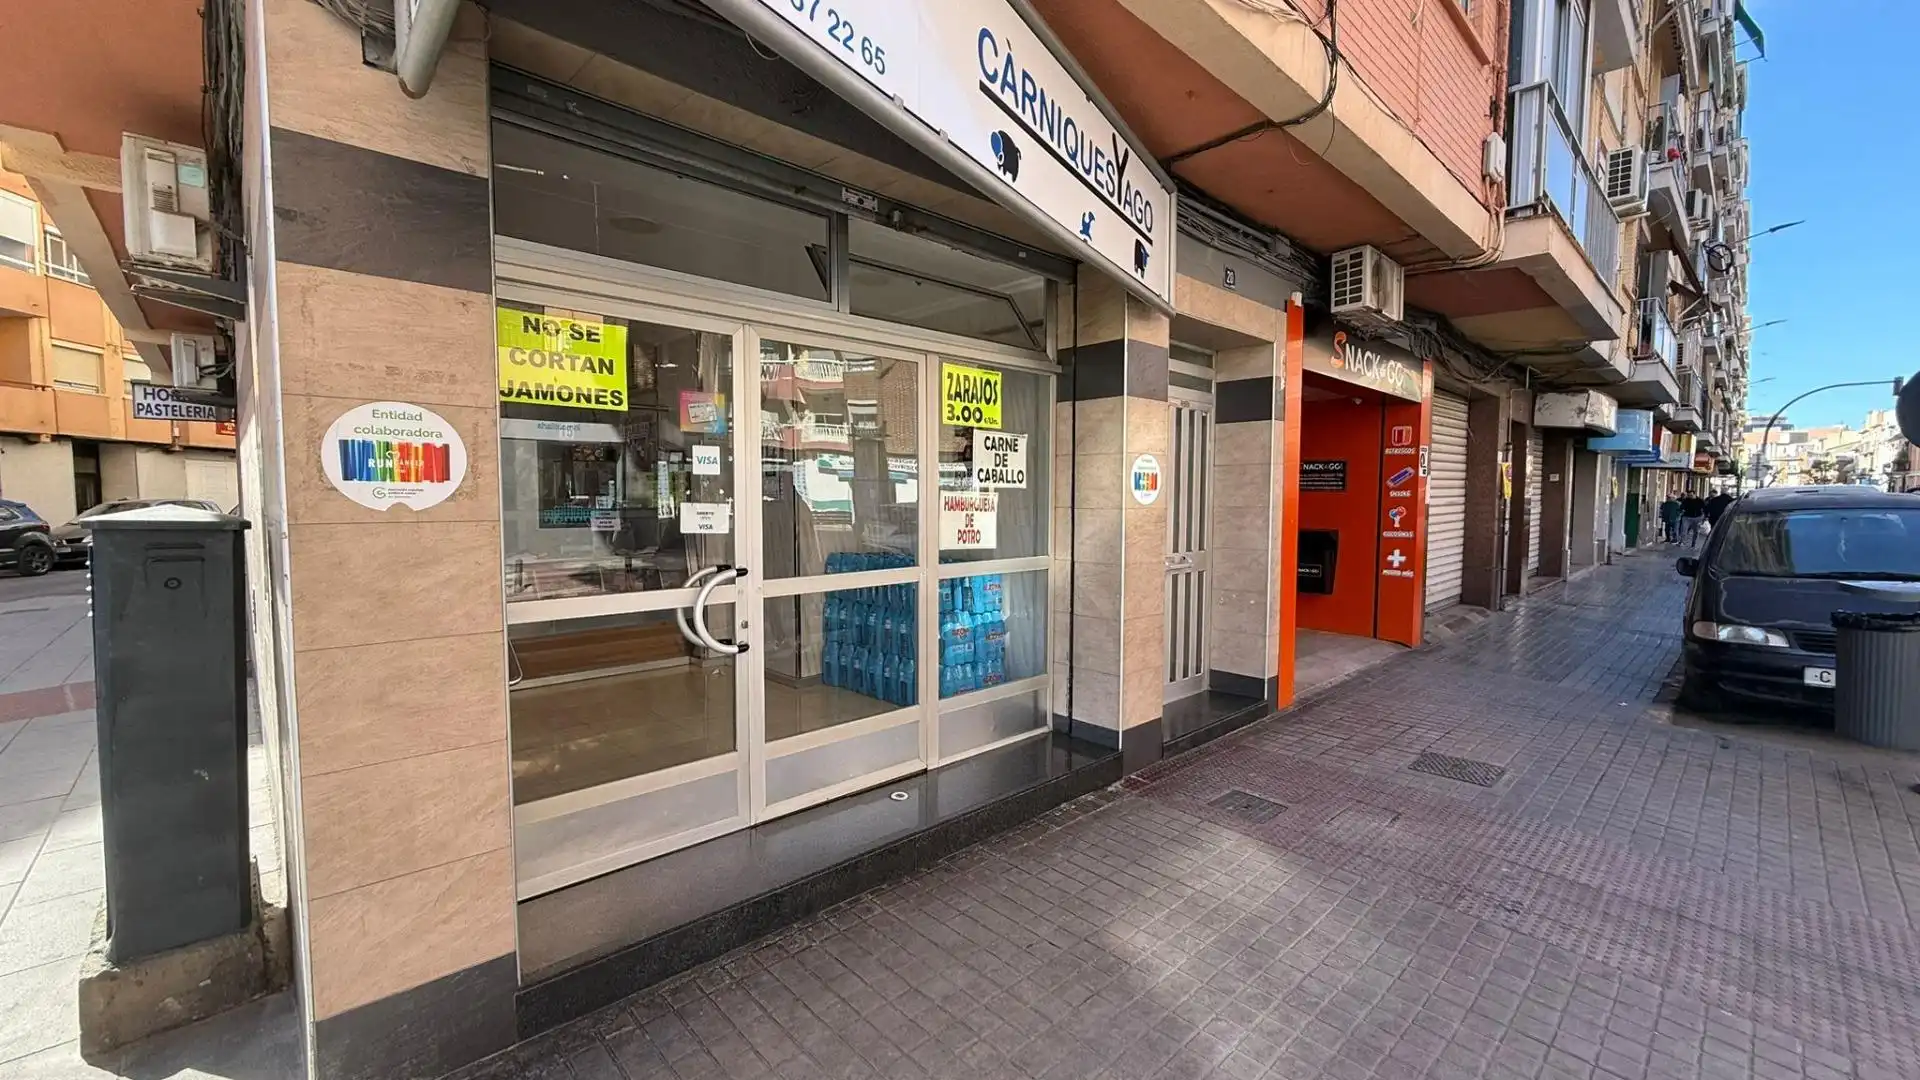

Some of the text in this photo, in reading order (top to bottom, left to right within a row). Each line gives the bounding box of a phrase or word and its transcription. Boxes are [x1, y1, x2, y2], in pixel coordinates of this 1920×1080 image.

[827, 8, 854, 53] 22
[861, 36, 885, 75] 65
[522, 315, 601, 343] NO SE
[508, 347, 614, 375] CORTAN
[499, 380, 624, 406] JAMONES
[946, 372, 998, 406] ZARAJOS
[372, 408, 423, 422] Entidad
[946, 403, 983, 424] 3.00
[353, 424, 443, 439] colaboradora
[984, 435, 1019, 452] CARNE
[696, 455, 718, 465] VISA
[994, 453, 1008, 467] DE
[977, 468, 1024, 484] CABALLO
[944, 495, 995, 512] HAMBURGUESA
[965, 513, 974, 528] DE
[957, 529, 981, 544] POTRO
